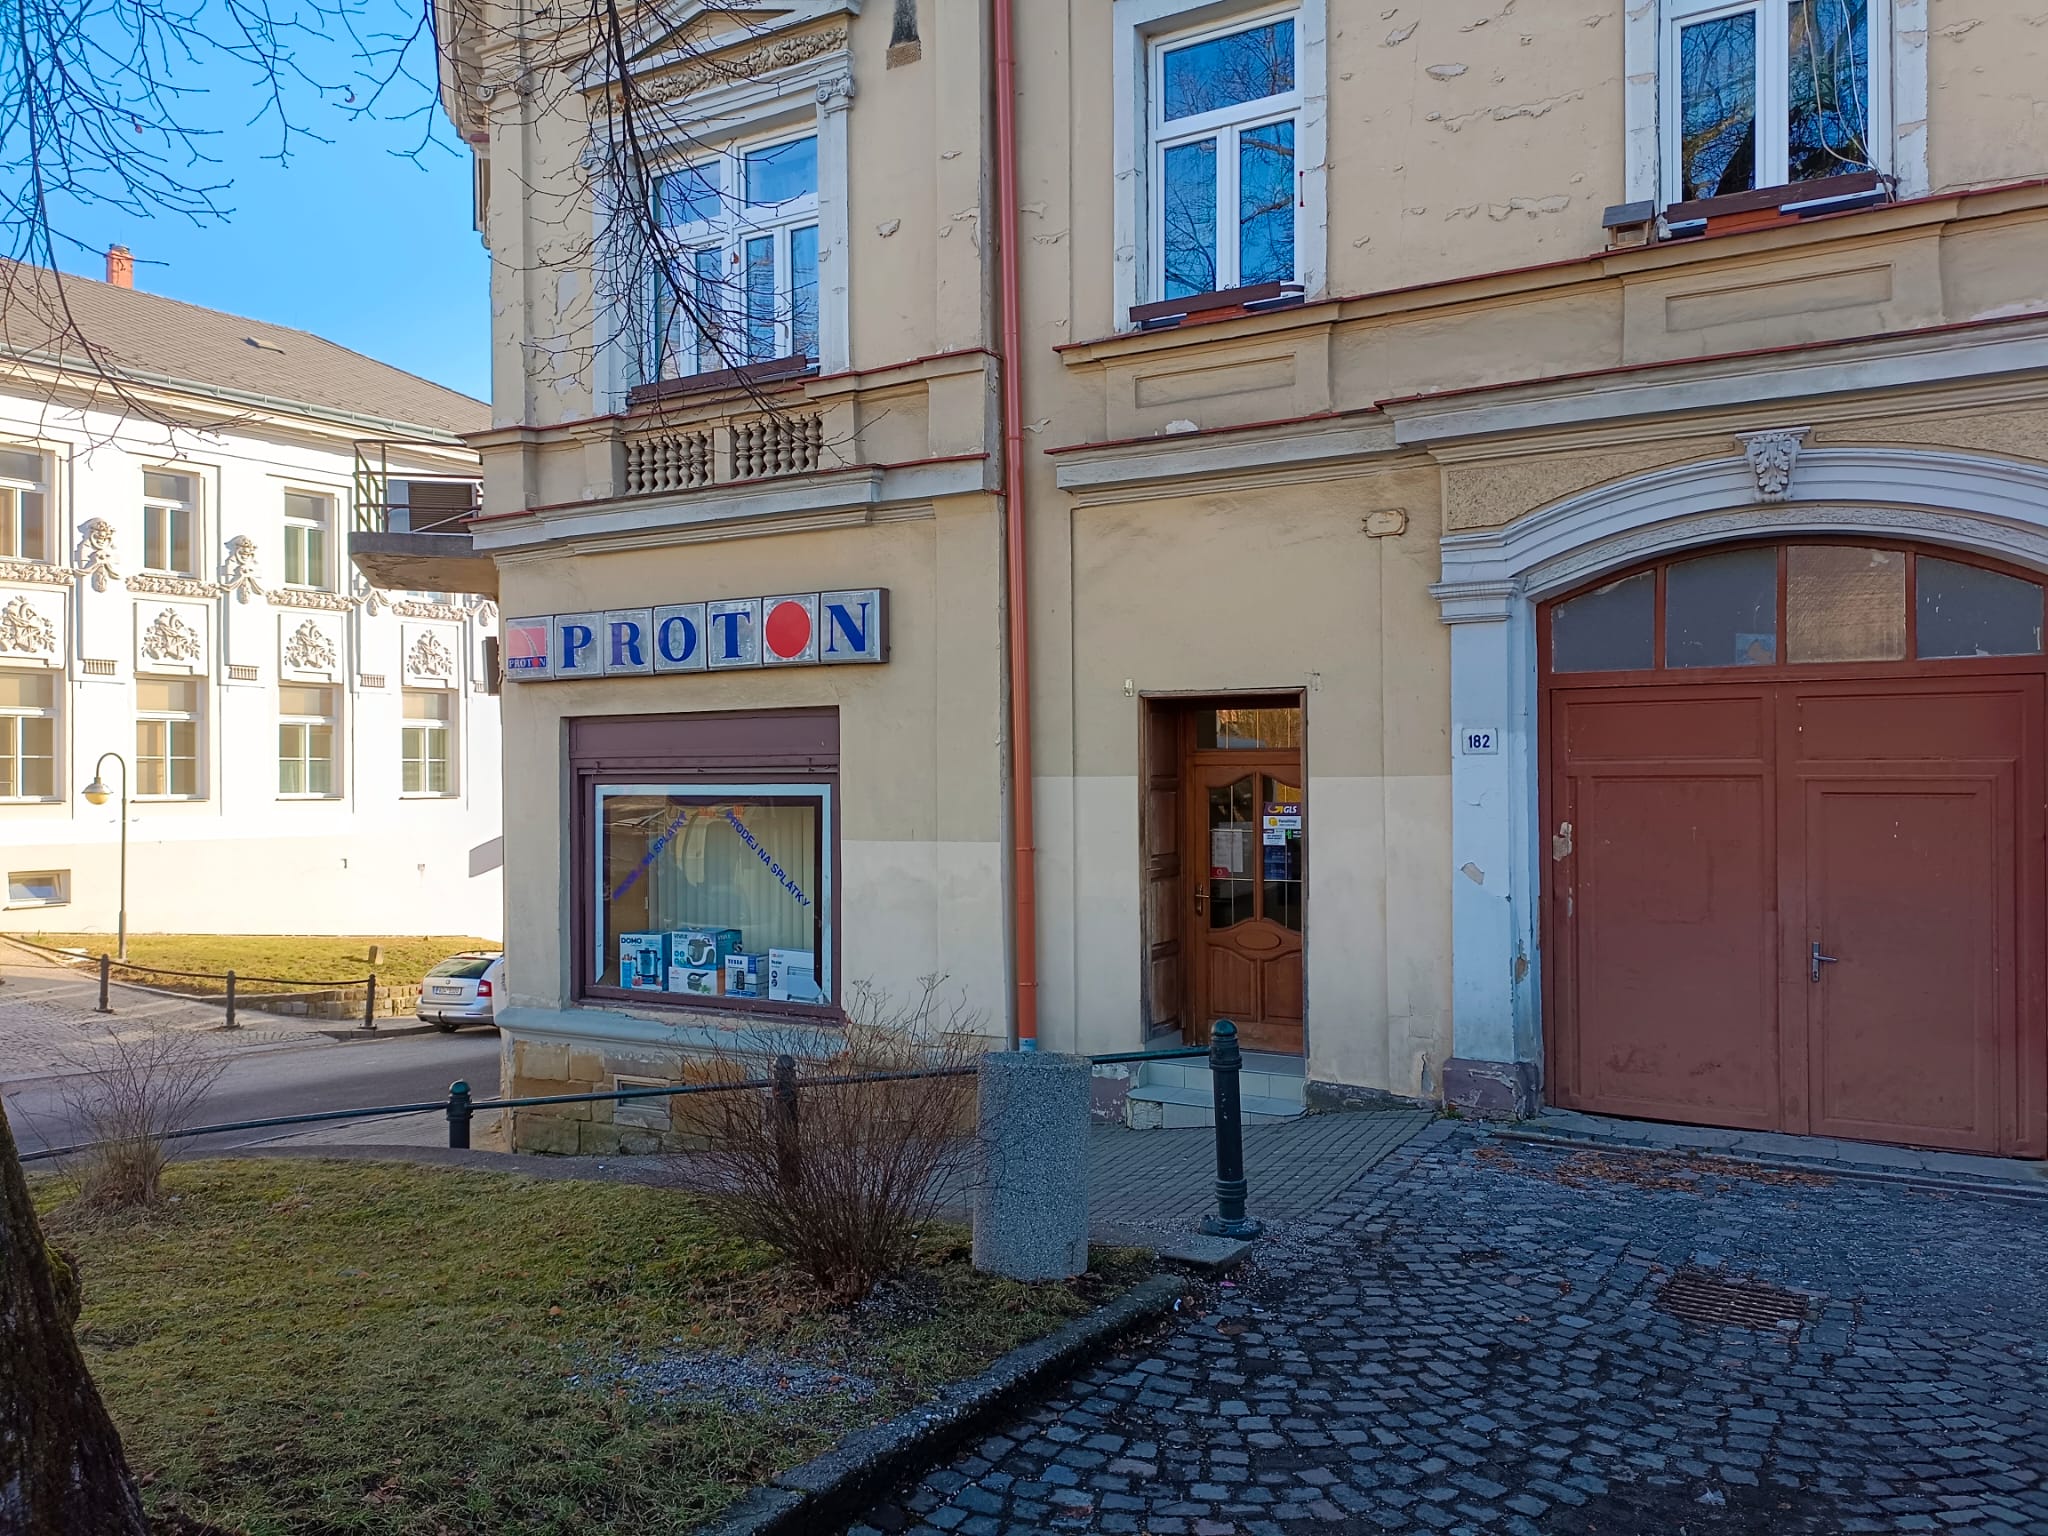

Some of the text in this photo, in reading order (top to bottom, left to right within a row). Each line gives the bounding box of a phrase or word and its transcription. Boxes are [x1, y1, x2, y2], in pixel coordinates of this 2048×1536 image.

[562, 601, 870, 669] PROTON
[508, 657, 547, 669] PROTON
[1468, 735, 1490, 748] 182
[1283, 805, 1298, 814] GLS
[726, 809, 811, 907] PRODEJ NA SPLÁTKY
